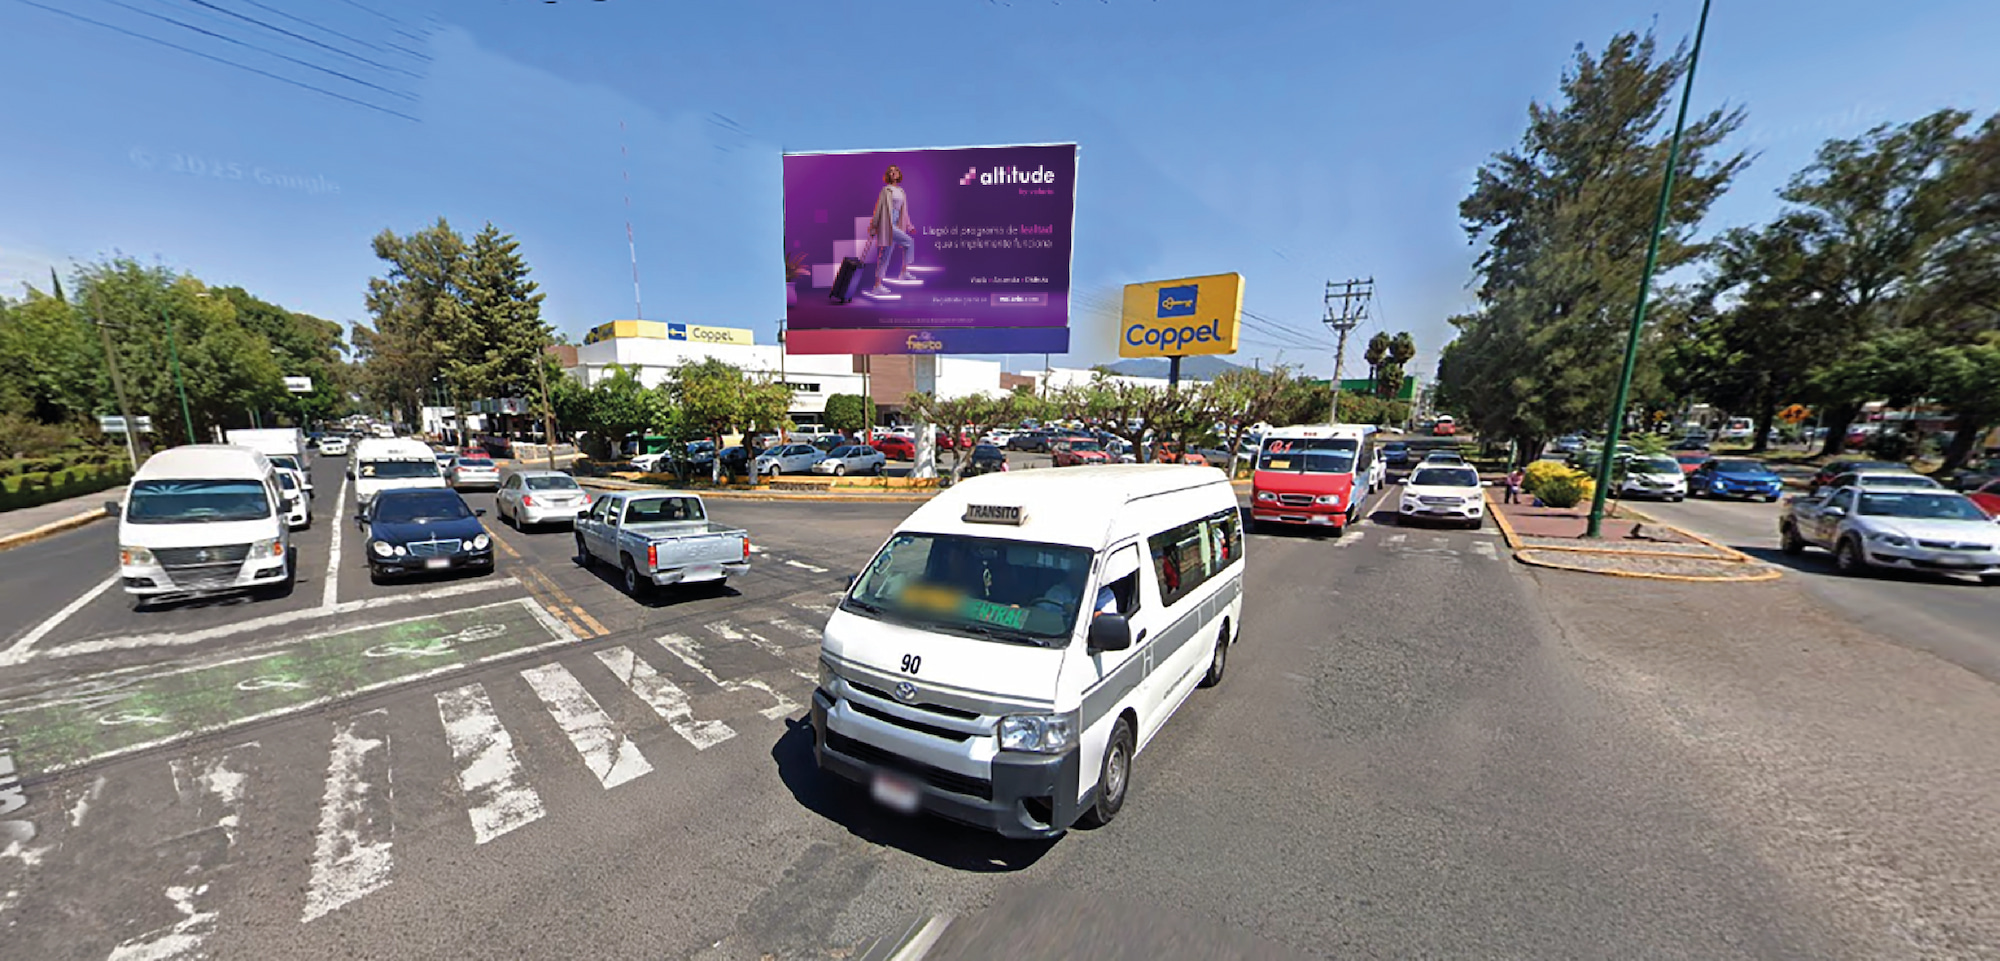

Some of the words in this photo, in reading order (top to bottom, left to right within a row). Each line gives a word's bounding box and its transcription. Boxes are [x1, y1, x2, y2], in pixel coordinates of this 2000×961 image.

[980, 164, 1055, 185] altitude
[692, 327, 734, 343] Coppel
[1125, 318, 1222, 351] Coppel
[969, 504, 1020, 520] TRANSITO
[900, 653, 922, 675] 90
